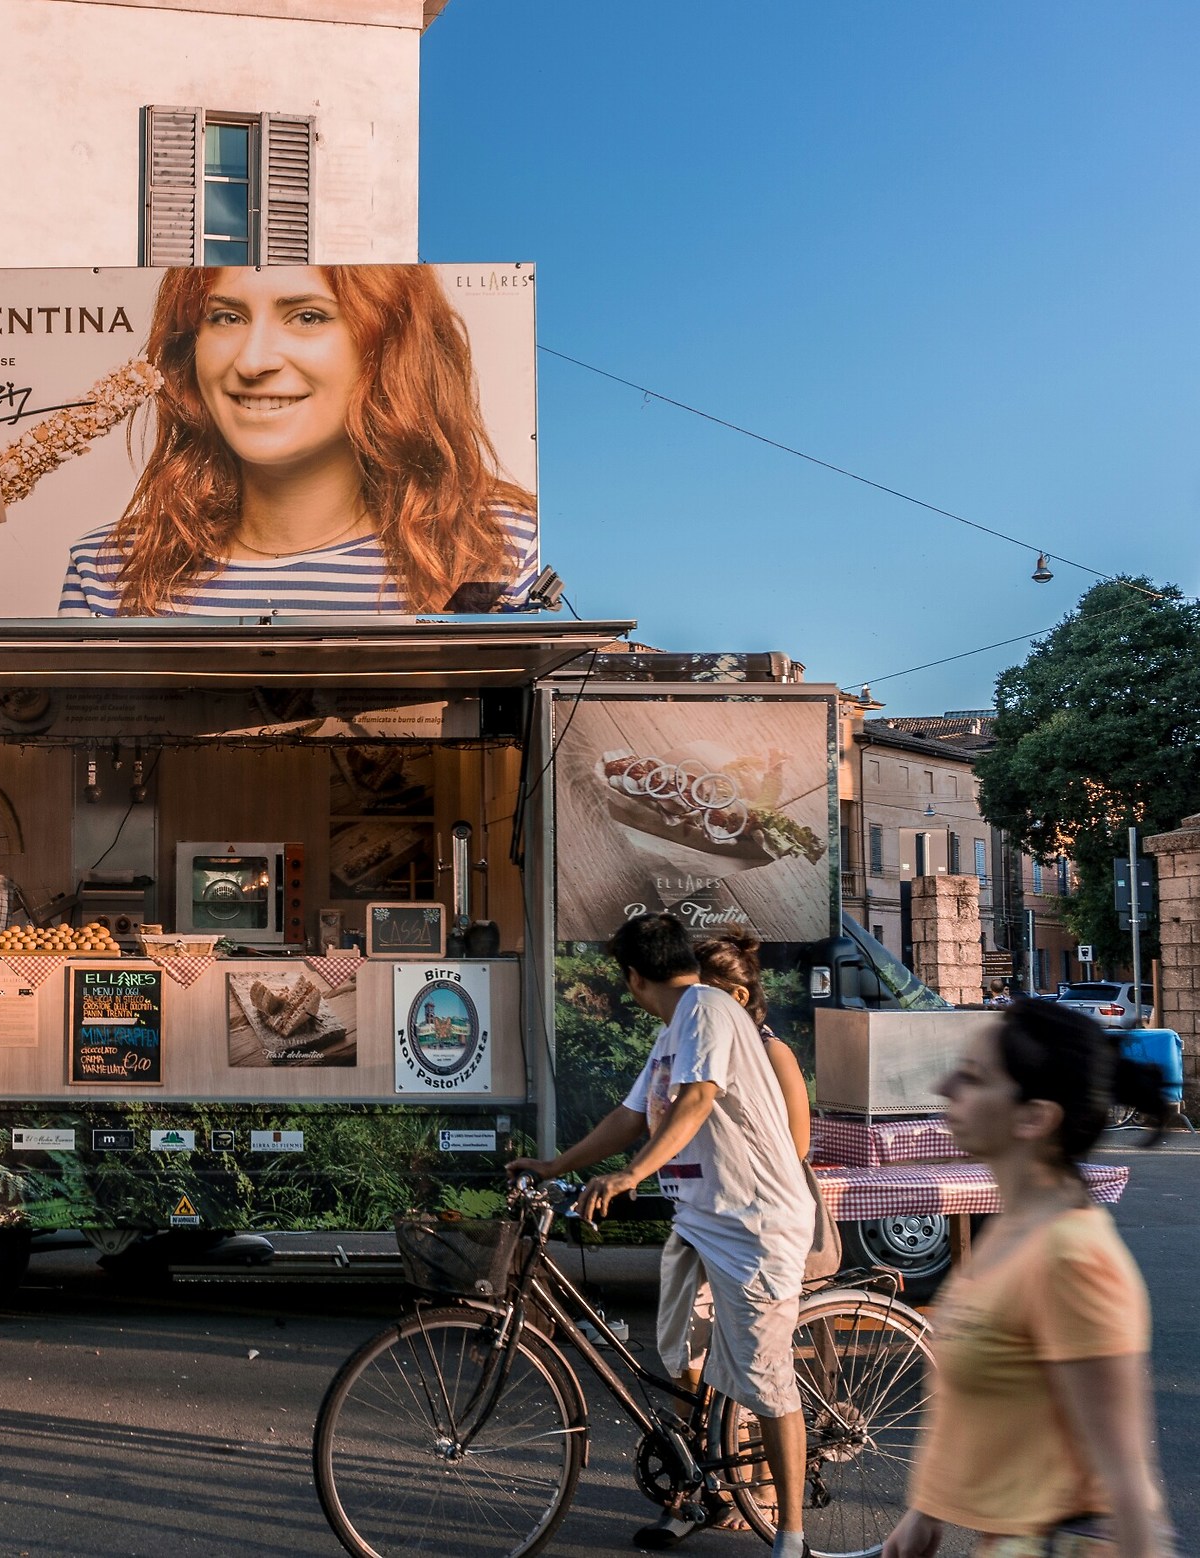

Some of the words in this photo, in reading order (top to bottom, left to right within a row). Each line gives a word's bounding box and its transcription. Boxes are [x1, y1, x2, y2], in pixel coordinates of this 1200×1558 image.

[456, 276, 471, 287] EL
[481, 272, 528, 290] LARES
[657, 878, 671, 889] EL
[681, 902, 749, 929] Trentin
[378, 919, 432, 944] CASSA
[86, 974, 107, 984] EL
[110, 971, 156, 986] LARES
[424, 968, 461, 983] Birra
[92, 987, 114, 996] MENU
[397, 1029, 415, 1070] Non
[416, 1030, 488, 1089] Pastorizzata
